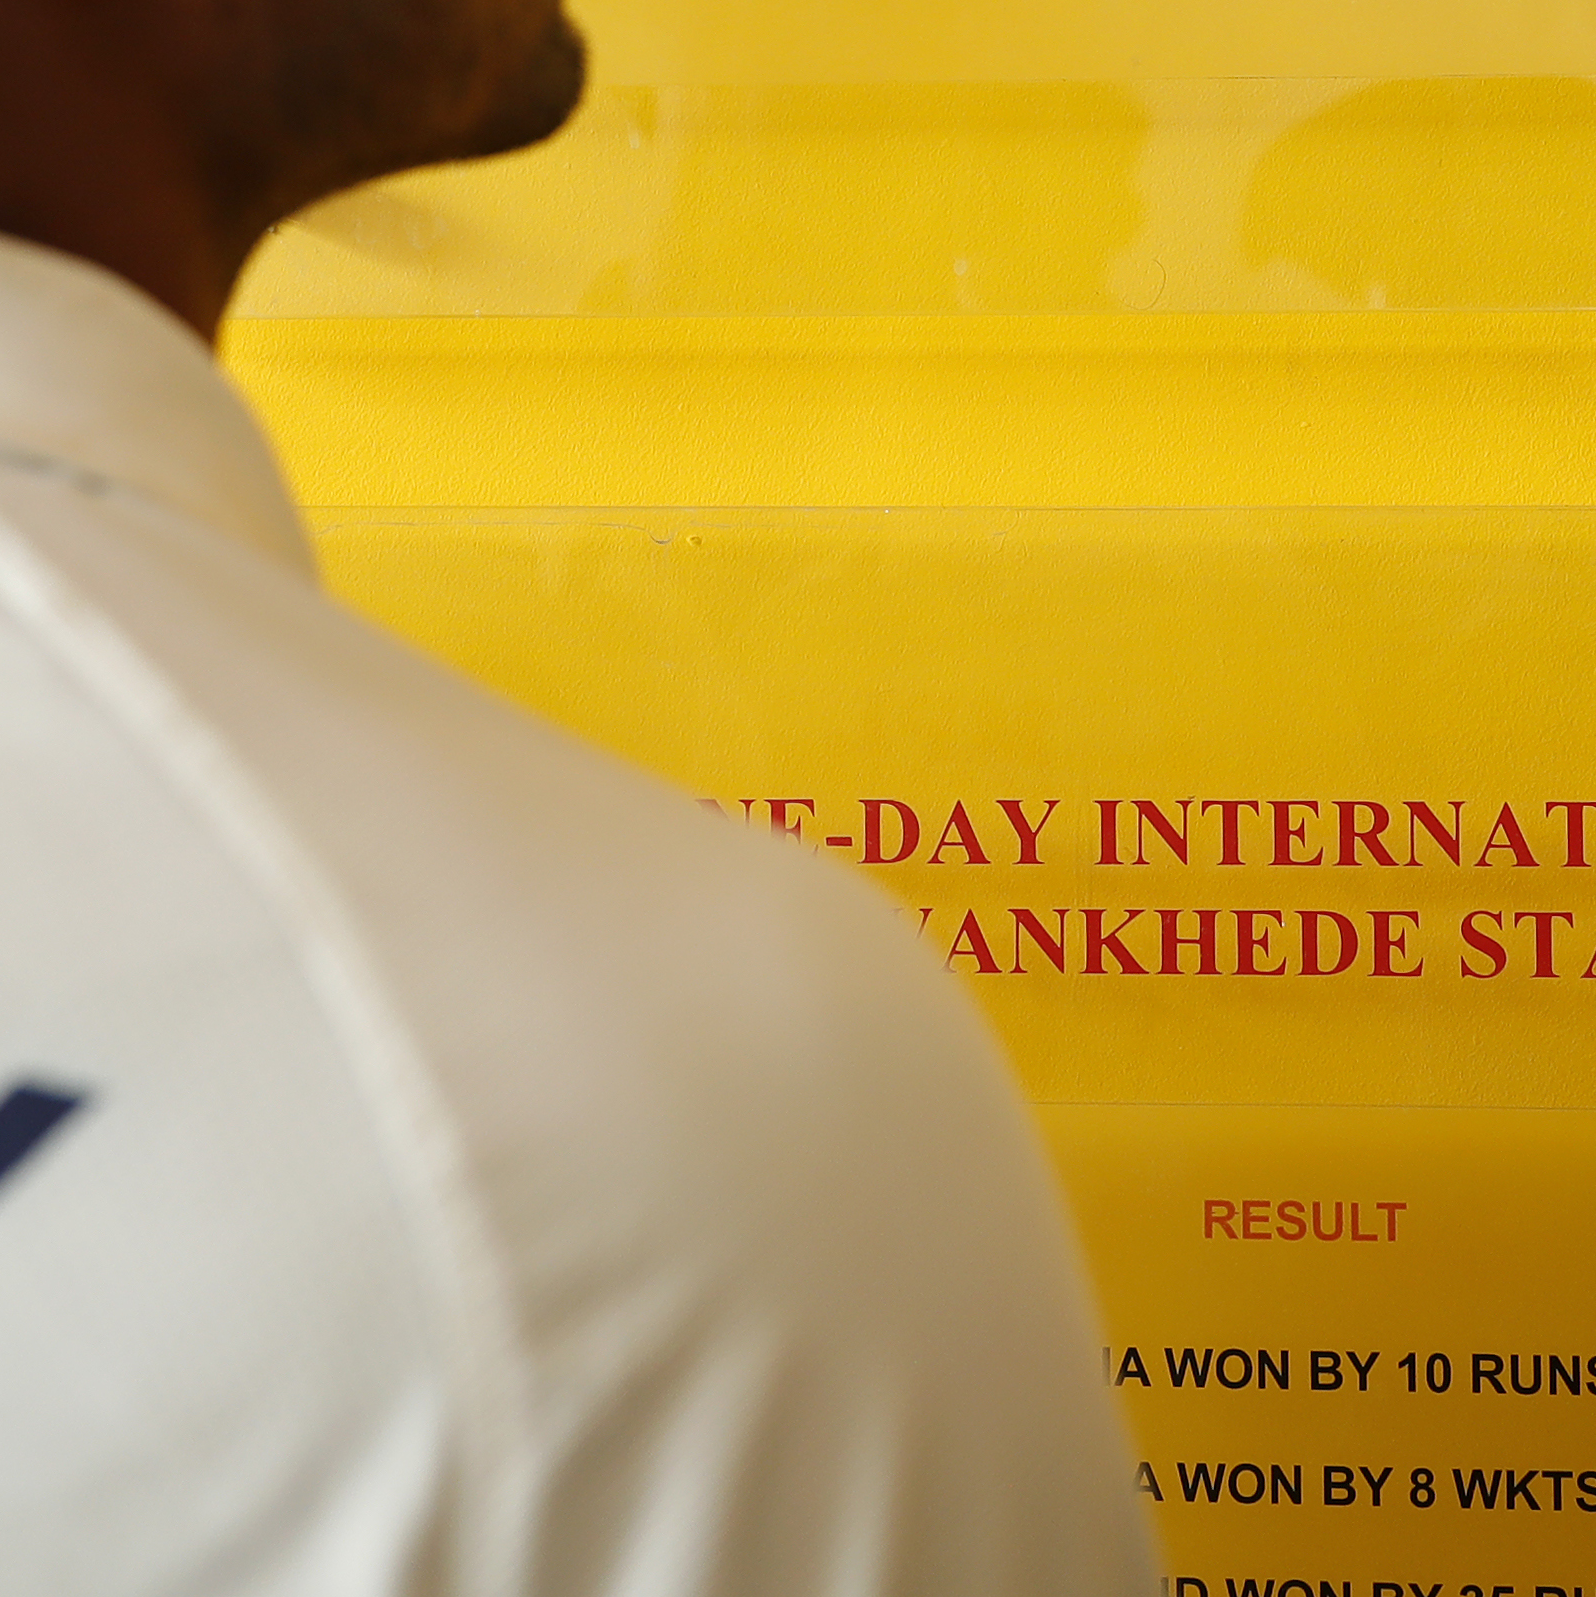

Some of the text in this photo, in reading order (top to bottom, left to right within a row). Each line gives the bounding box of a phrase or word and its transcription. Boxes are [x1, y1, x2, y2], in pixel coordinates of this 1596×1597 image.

[918, 907, 1424, 978] ANKHEDE
[1204, 1199, 1407, 1242] RESULT
[1163, 1347, 1290, 1391] WON
[1310, 1350, 1381, 1392] BY
[1397, 1351, 1452, 1394] 10
[1176, 1462, 1302, 1505] WON
[1323, 1465, 1394, 1507] BY
[1409, 1467, 1436, 1509] 8
